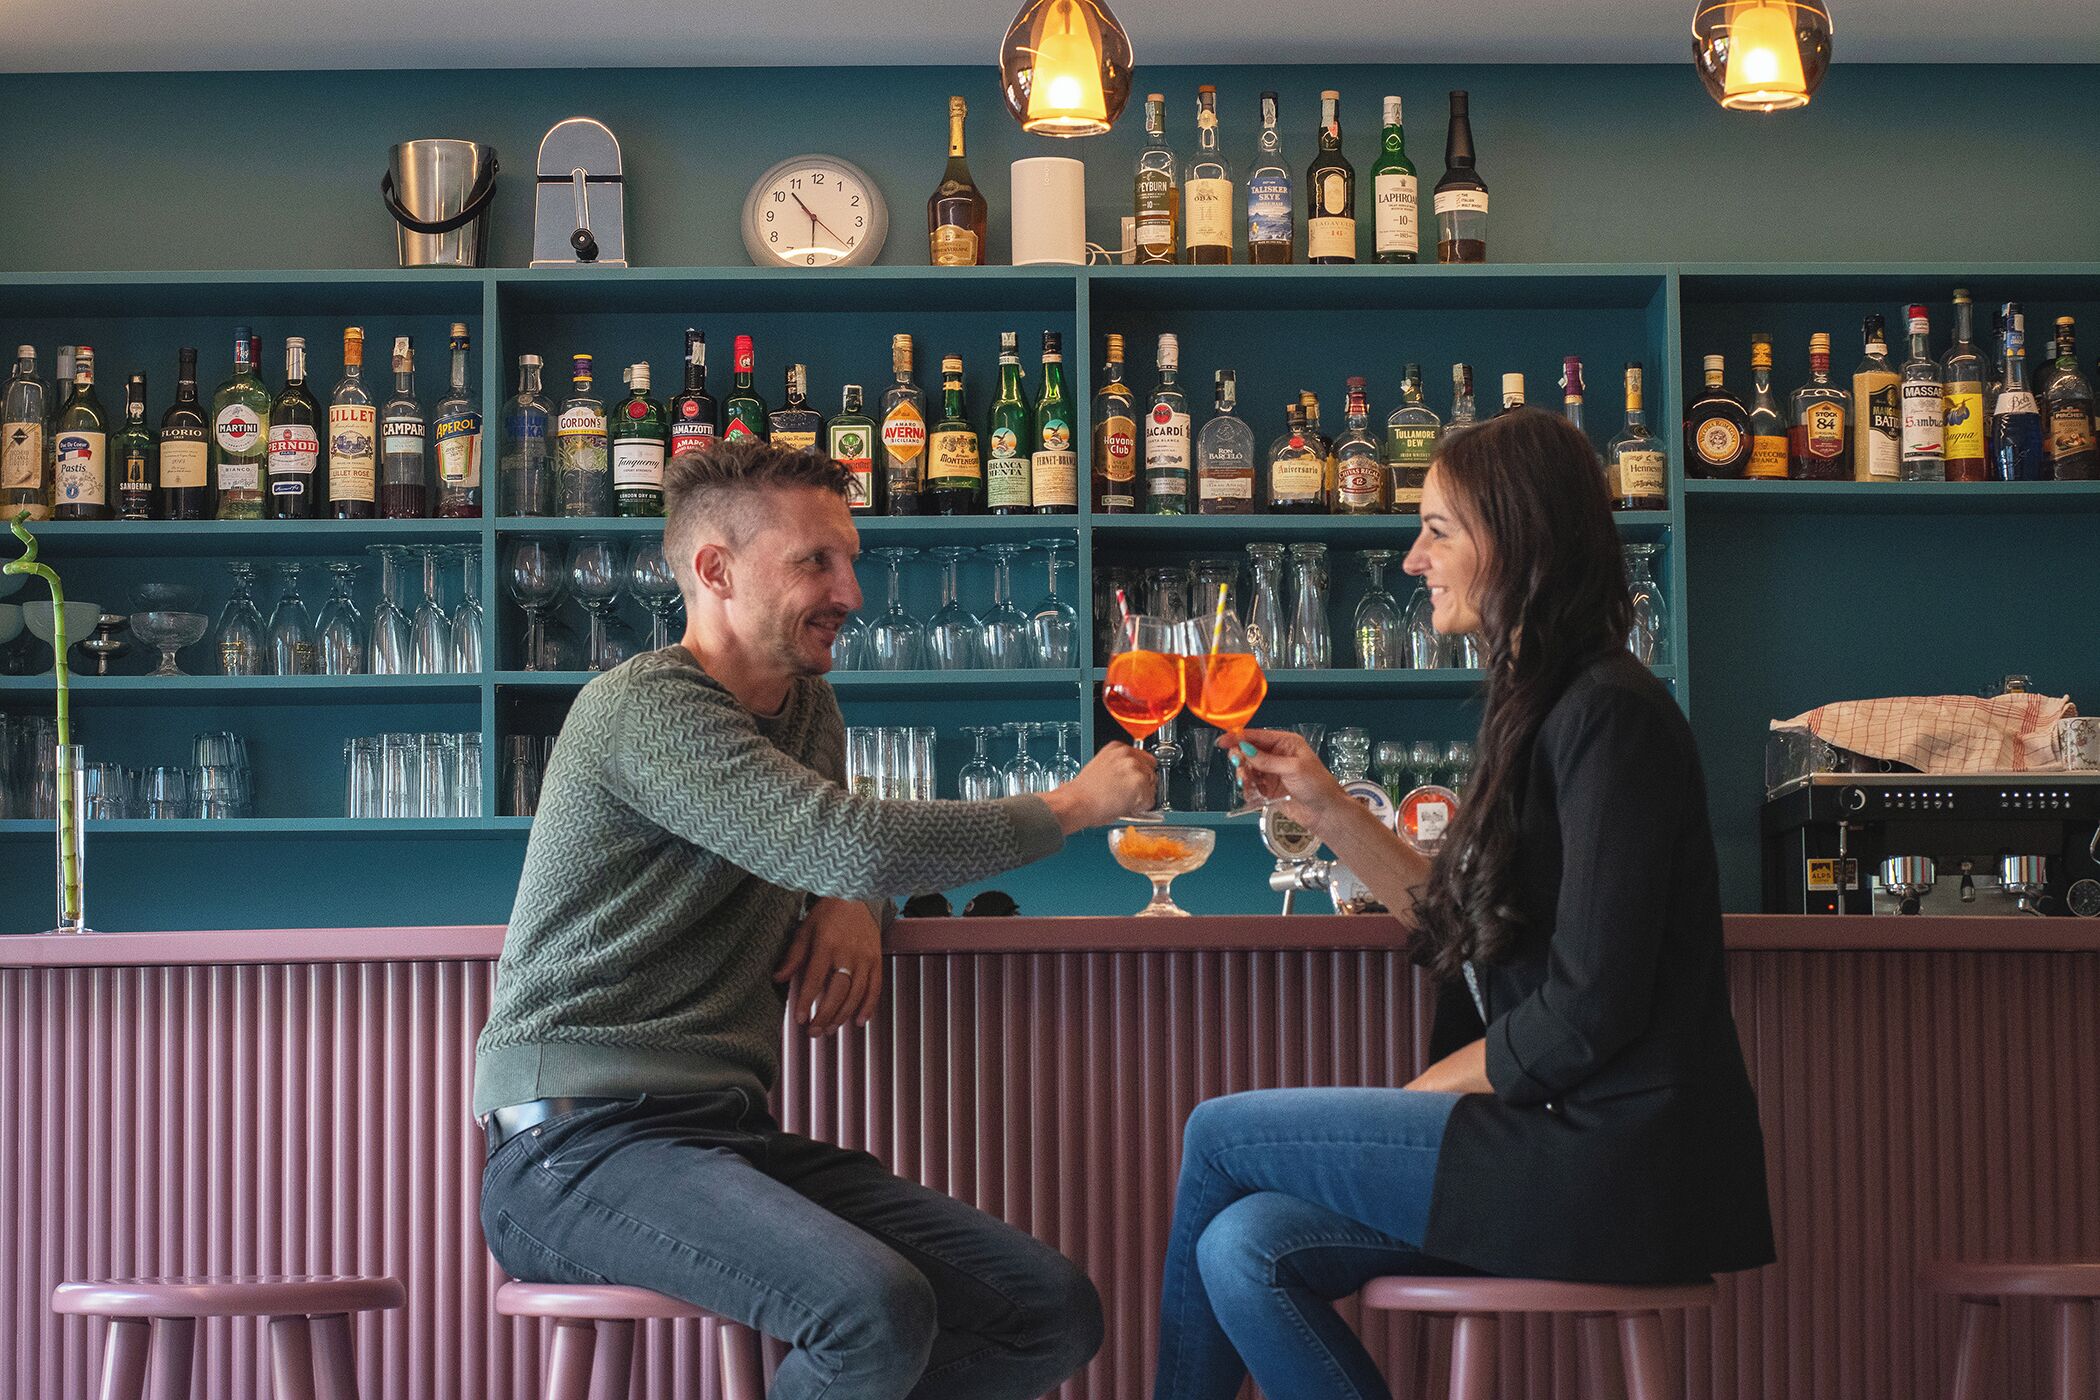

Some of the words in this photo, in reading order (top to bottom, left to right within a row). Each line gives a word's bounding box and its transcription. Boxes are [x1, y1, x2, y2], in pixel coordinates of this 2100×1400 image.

[790, 178, 802, 190] 11
[811, 173, 825, 185] 12
[836, 181, 843, 192] 1
[1251, 186, 1288, 194] TALISKER
[772, 191, 786, 203] 10
[850, 195, 860, 207] 2
[1258, 193, 1281, 201] SKYE
[1146, 200, 1154, 209] 10
[765, 210, 775, 222] 9
[1399, 215, 1409, 226] 10
[854, 216, 864, 228] 3
[769, 231, 779, 243] 8
[846, 236, 855, 248] 4
[806, 253, 815, 266] 6
[2010, 393, 2030, 412] Bols
[330, 409, 375, 423] LILLET
[219, 424, 257, 432] MARTINI
[561, 418, 601, 428] GORDON'S
[1816, 418, 1836, 430] 84
[161, 429, 203, 438] FLORIO
[383, 423, 425, 436] CAMPARI
[436, 419, 476, 439] APEROL
[884, 427, 925, 440] AVERNA
[1394, 428, 1435, 439] TULLAMORE
[1104, 436, 1134, 446] Havana
[1407, 439, 1424, 447] DEW
[1110, 445, 1129, 454] Club
[1754, 451, 1787, 459] AVECCHIO
[617, 456, 660, 468] Tanqueray
[988, 461, 1023, 470] BRANCA
[61, 464, 87, 473] Pastis
[988, 469, 1022, 477] MENTA
[1278, 465, 1319, 475] Aniversario
[1338, 468, 1360, 479] CHIVAS
[1360, 468, 1379, 479] REGAL
[119, 482, 152, 491] SANDEMAN
